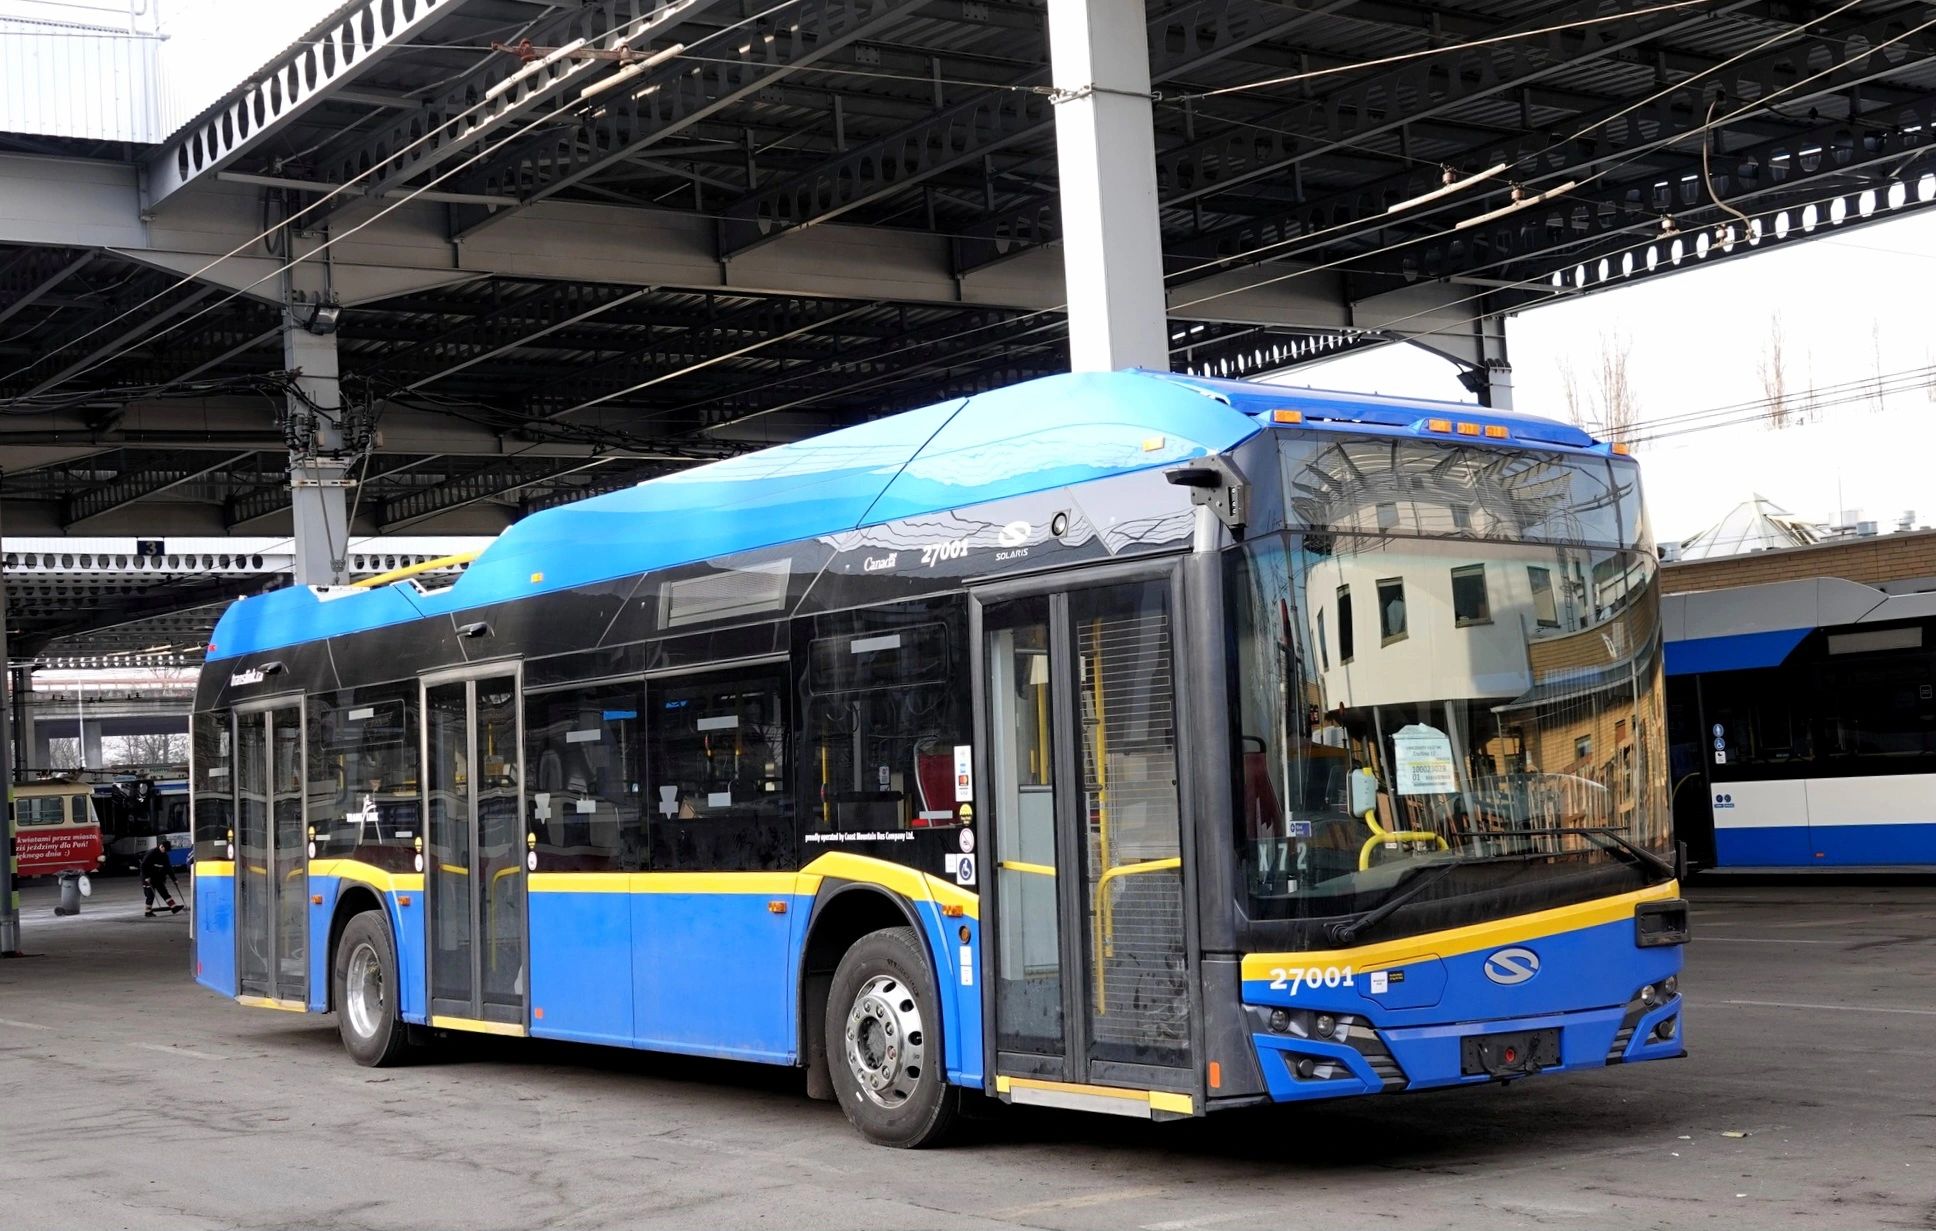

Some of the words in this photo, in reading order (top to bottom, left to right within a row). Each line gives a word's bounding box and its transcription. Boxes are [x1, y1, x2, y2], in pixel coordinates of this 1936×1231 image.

[145, 541, 157, 555] 3
[921, 538, 969, 568] 27001
[995, 547, 1029, 561] SOLARIS
[17, 836, 51, 844] kwiatami
[51, 835, 71, 843] przez
[885, 831, 906, 842] Company
[15, 851, 44, 861] ięknego
[1269, 965, 1355, 997] 27001
